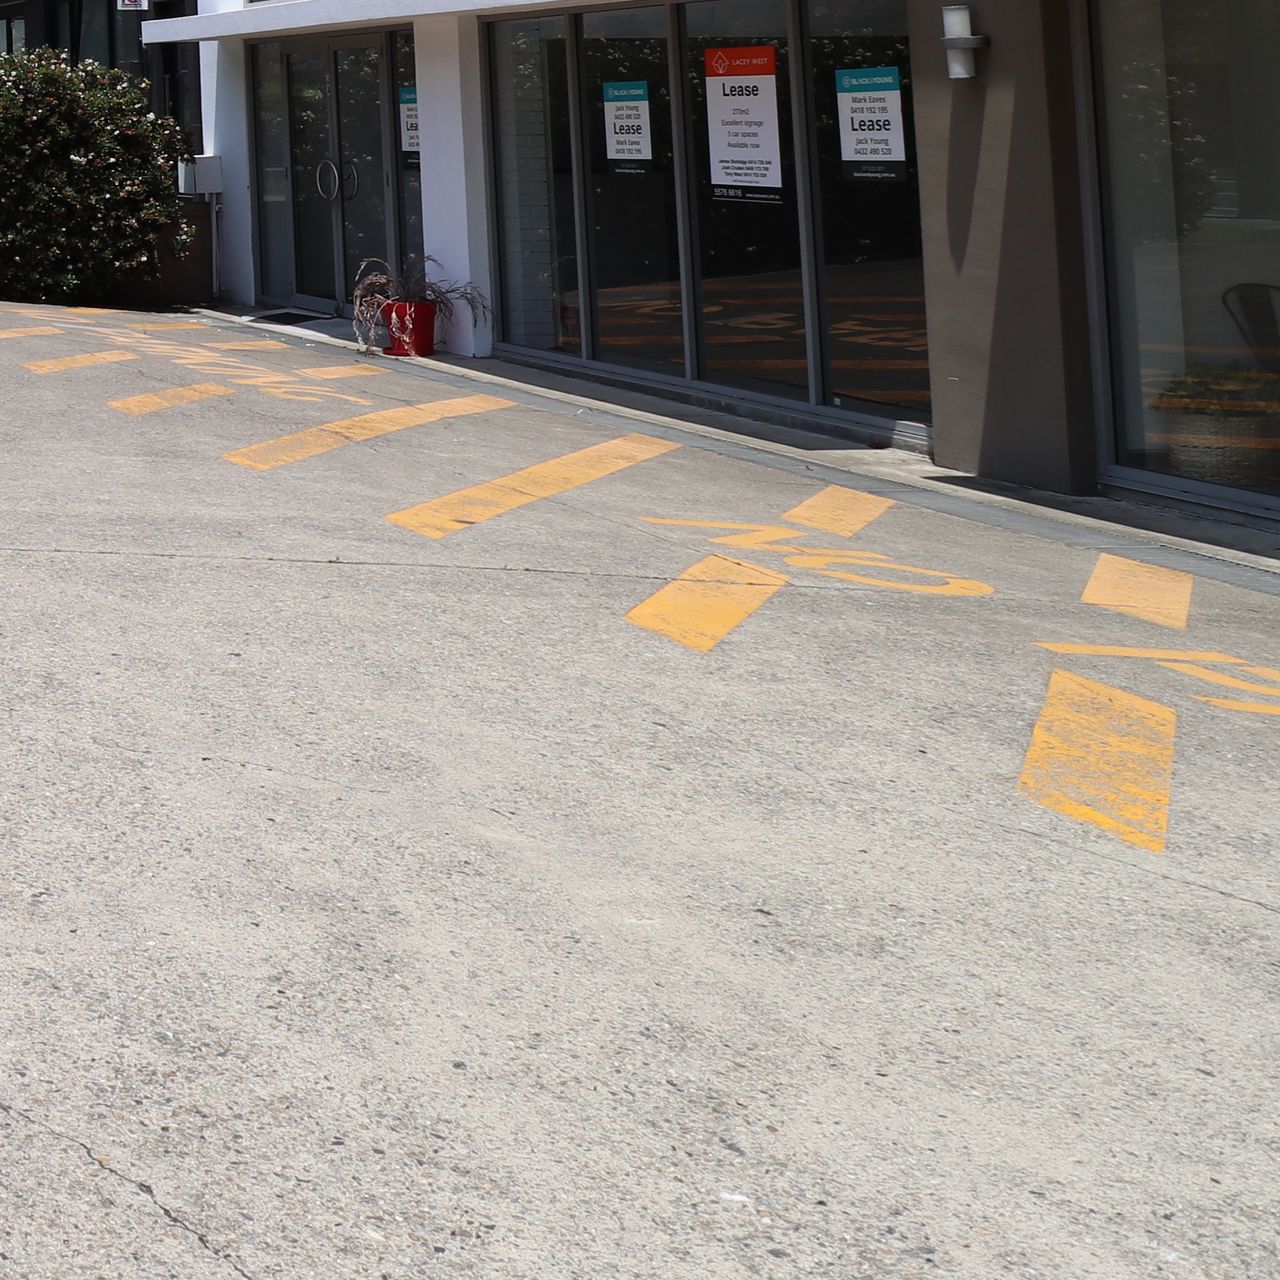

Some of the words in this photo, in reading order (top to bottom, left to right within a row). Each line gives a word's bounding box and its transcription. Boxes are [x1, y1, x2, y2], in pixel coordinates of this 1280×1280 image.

[722, 82, 759, 97] Lease
[406, 121, 418, 131] Lea
[613, 122, 642, 134] Lease
[850, 117, 891, 131] Lease
[856, 138, 868, 146] Jack
[870, 138, 889, 146] Young
[640, 517, 997, 597] NO
